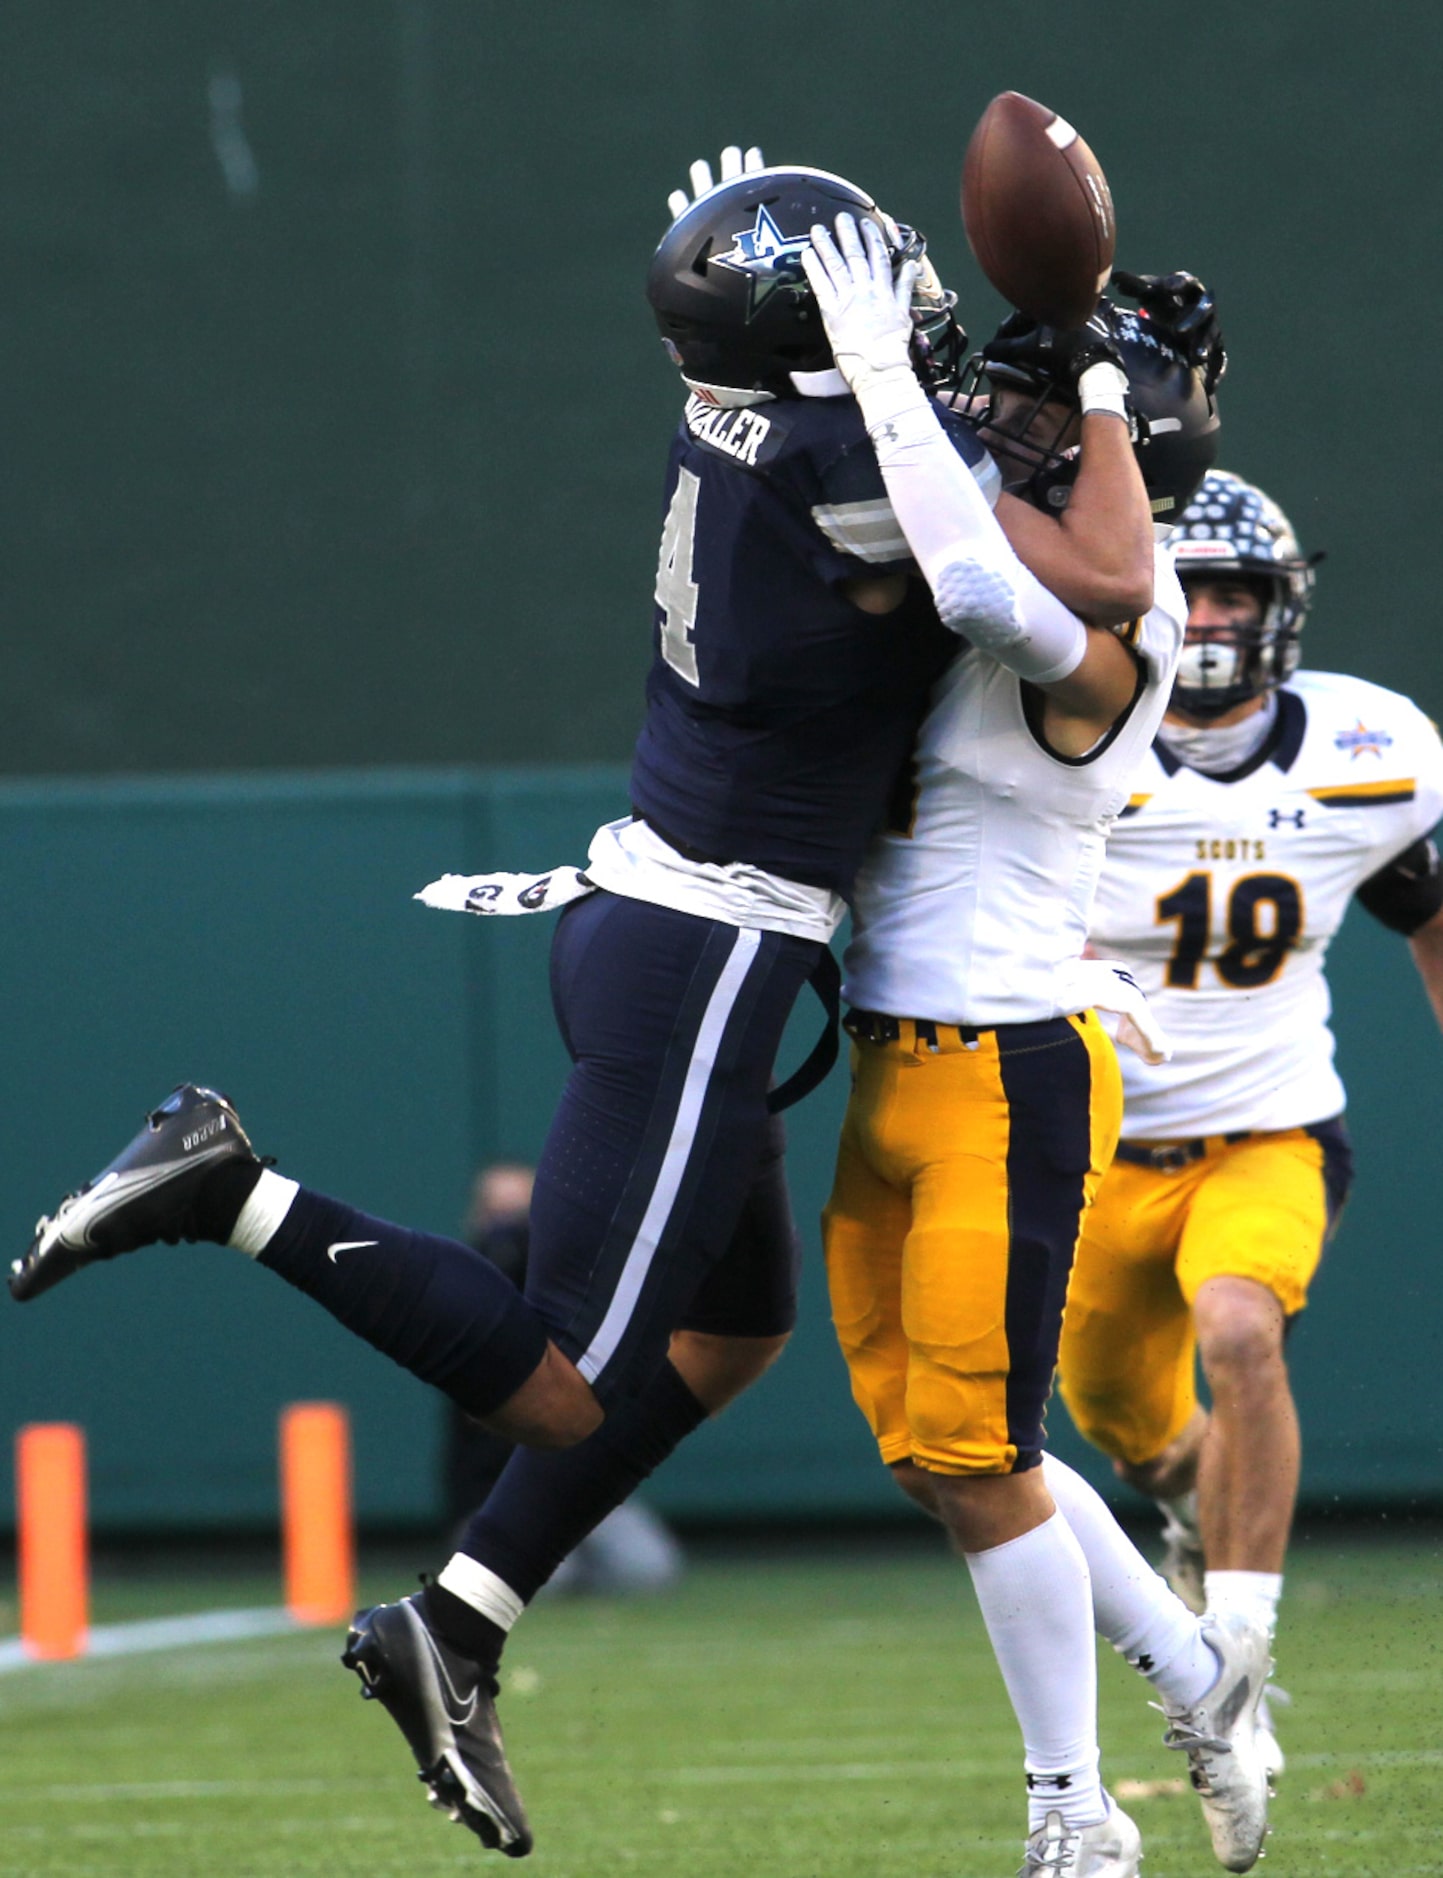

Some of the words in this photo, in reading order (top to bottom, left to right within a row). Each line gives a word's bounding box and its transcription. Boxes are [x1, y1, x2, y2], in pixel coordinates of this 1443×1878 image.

[654, 464, 701, 688] 4
[1196, 838, 1265, 861] SCOTS
[182, 1114, 227, 1151] VAPOR
